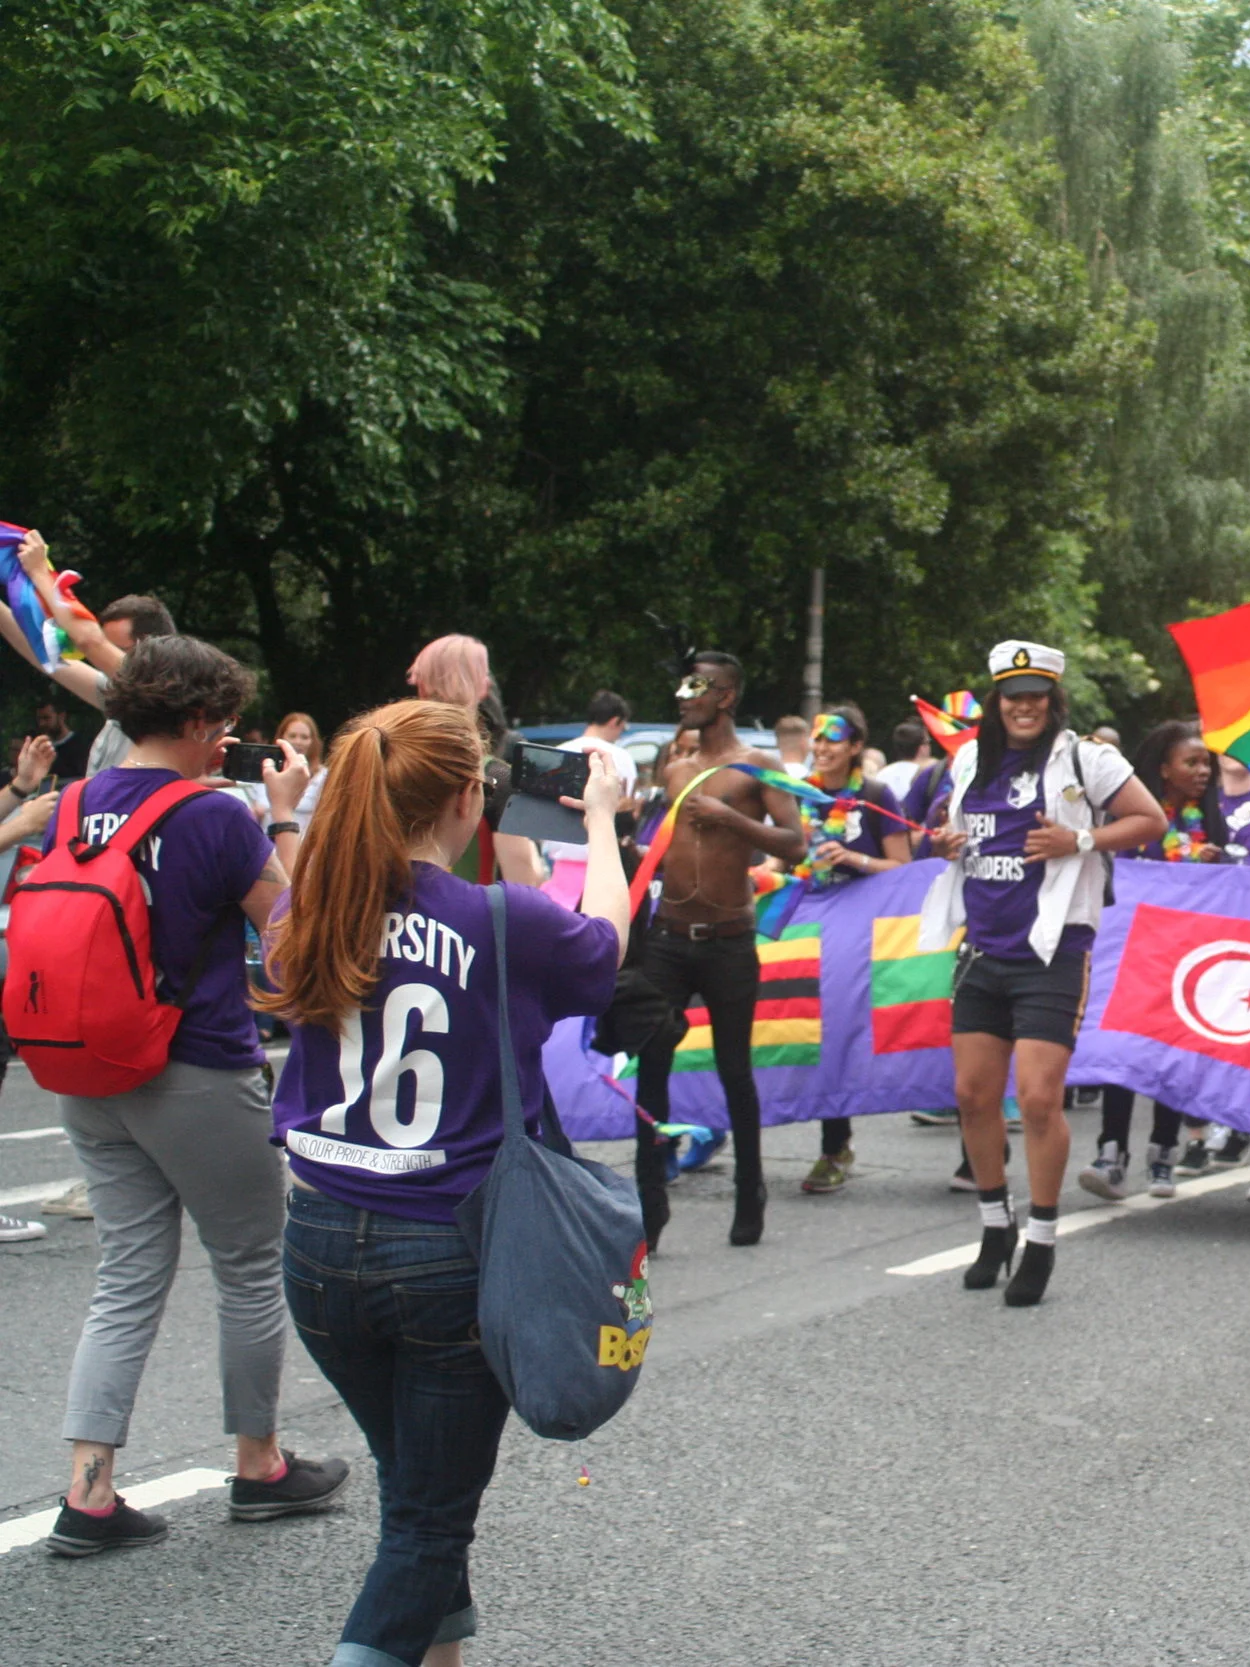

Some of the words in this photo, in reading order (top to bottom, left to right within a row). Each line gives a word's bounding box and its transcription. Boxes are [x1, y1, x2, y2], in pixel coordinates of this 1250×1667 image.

[379, 911, 476, 991] RSITY
[321, 982, 449, 1149] 16
[298, 1136, 308, 1154] IS
[308, 1139, 333, 1161] OUR
[334, 1145, 370, 1166] PRIDE
[369, 1152, 379, 1168] &
[379, 1153, 432, 1172] STRENGTH
